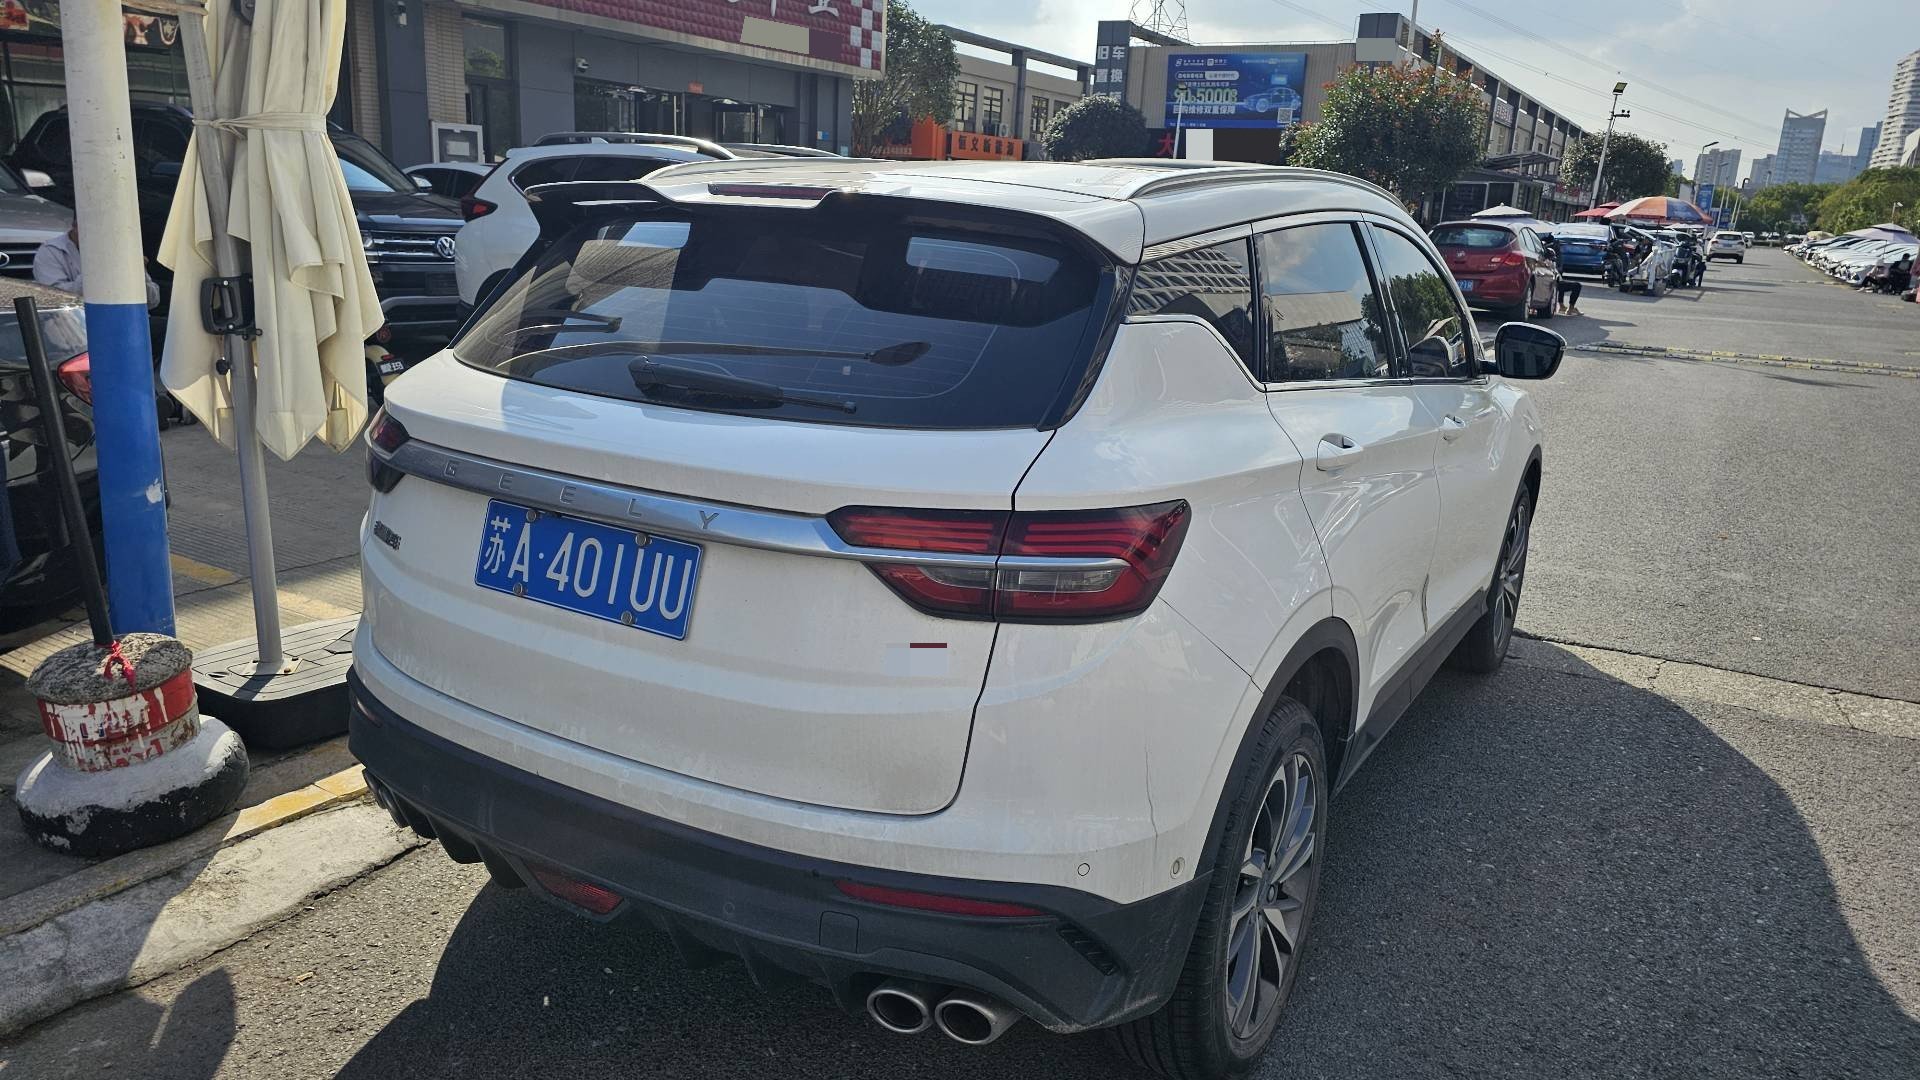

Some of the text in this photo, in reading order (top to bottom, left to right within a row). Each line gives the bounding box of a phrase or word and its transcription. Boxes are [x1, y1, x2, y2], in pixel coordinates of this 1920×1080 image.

[1097, 45, 1126, 60] 旧车
[1096, 68, 1123, 82] 置换
[443, 459, 719, 530] GEELY
[483, 515, 693, 620] 苏A·401UU
